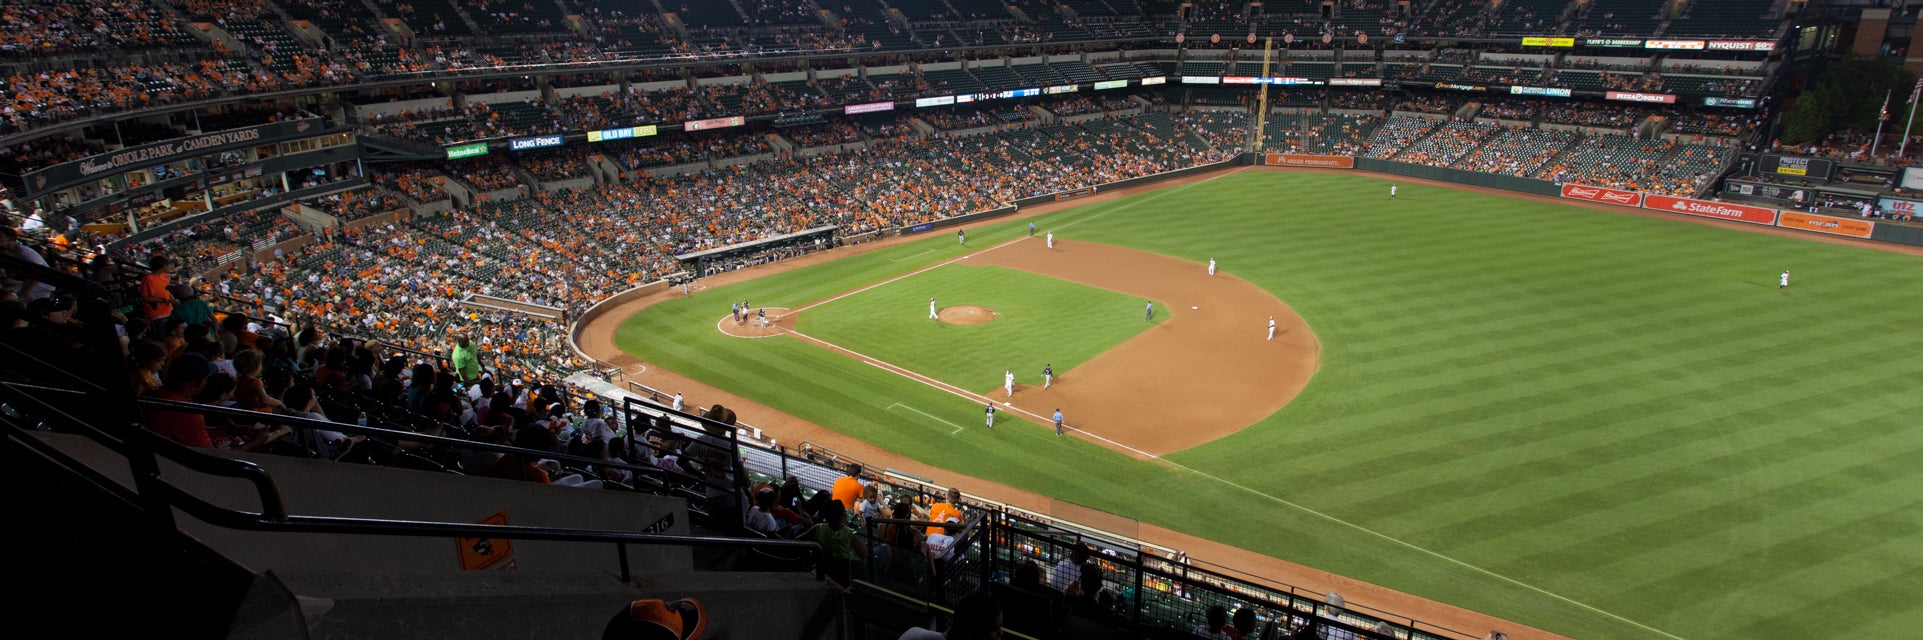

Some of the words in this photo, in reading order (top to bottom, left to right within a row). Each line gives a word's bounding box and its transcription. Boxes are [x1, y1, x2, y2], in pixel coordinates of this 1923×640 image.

[1546, 88, 1571, 97] UNION
[603, 130, 617, 139] OLD
[618, 128, 632, 137] BAY
[111, 150, 149, 168] ORIOLE
[149, 143, 174, 159] PARK
[183, 134, 226, 151] CAMDEN
[226, 129, 260, 143] YARDS
[513, 140, 534, 149] LONG
[535, 137, 560, 146] FENCE
[447, 146, 480, 158] Heineken
[1779, 156, 1809, 165] PROTECT
